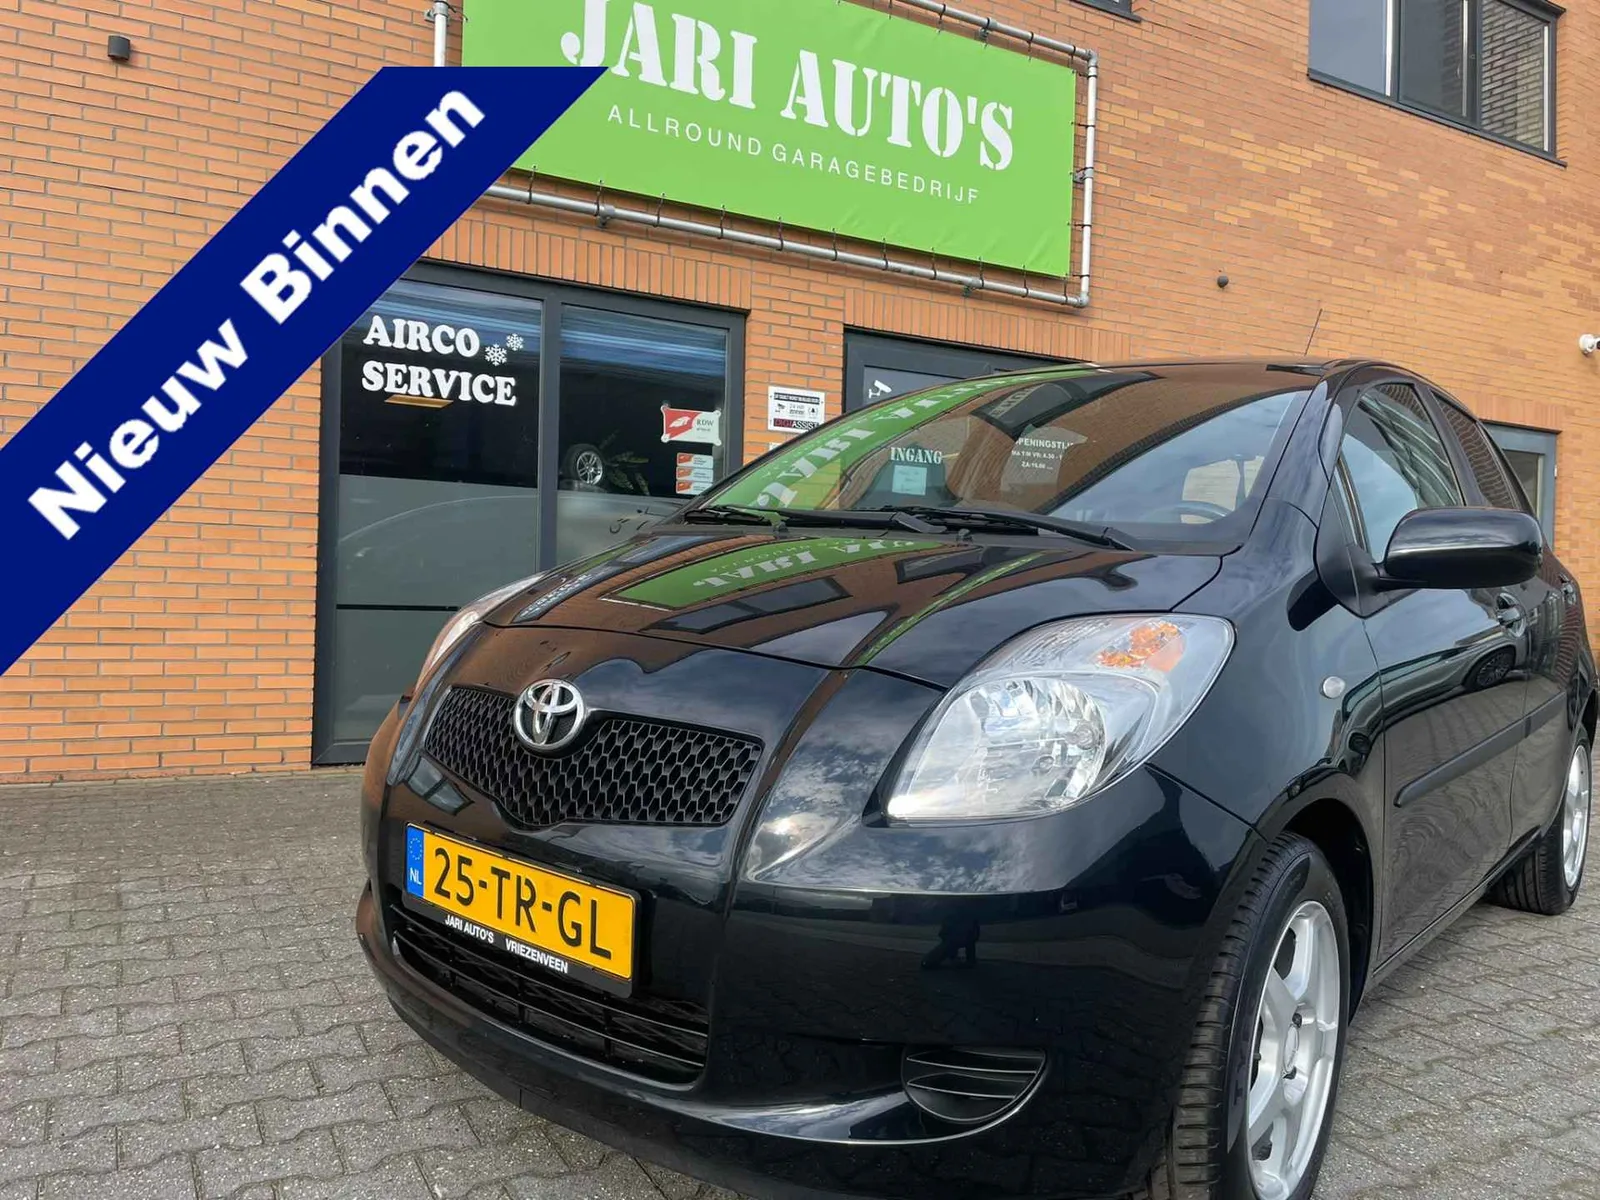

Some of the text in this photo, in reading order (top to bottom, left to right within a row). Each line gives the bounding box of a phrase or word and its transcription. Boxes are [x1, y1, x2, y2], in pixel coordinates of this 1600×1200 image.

[560, 0, 1014, 171] JARI AUTO'S
[607, 104, 980, 204] ALLROUND GARAGEBEDRIJF
[362, 314, 481, 358] AIRCO
[361, 360, 517, 407] SERVICE
[889, 447, 943, 465] INGANG
[409, 867, 422, 886] NL
[433, 847, 612, 961] 25-TR-GL
[445, 914, 568, 974] JARI AUTO'S VRIEZENVEEN
